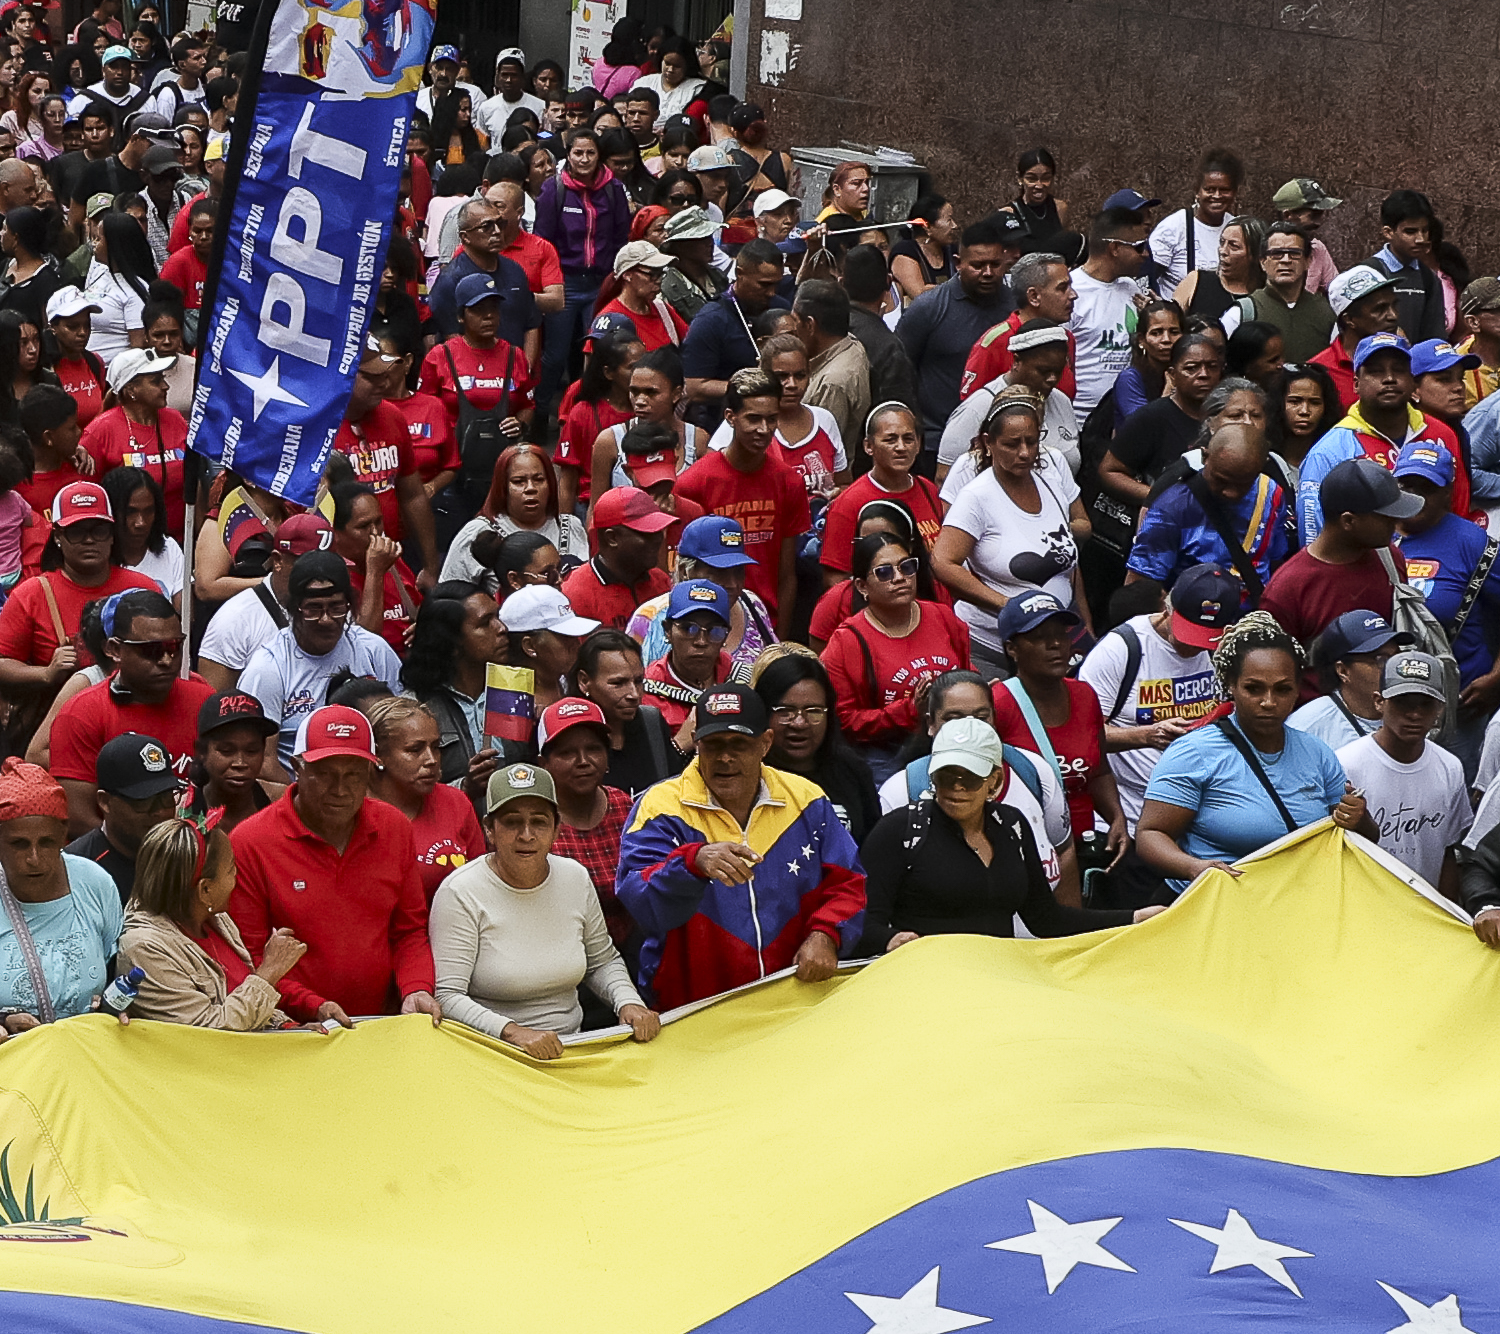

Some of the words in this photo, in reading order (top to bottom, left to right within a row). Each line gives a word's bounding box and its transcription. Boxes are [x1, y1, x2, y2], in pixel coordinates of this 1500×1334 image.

[244, 123, 273, 179] SEGURA
[383, 116, 406, 168] ÉTICA
[257, 101, 368, 369] PPT
[356, 220, 383, 281] GESTIÓN
[352, 282, 371, 307] DE
[339, 307, 368, 375] CONTROL
[892, 667, 910, 685] YOU
[931, 655, 949, 667] YOU
[1138, 680, 1173, 705] MÁS
[1152, 699, 1214, 720] SOLUCIONE
